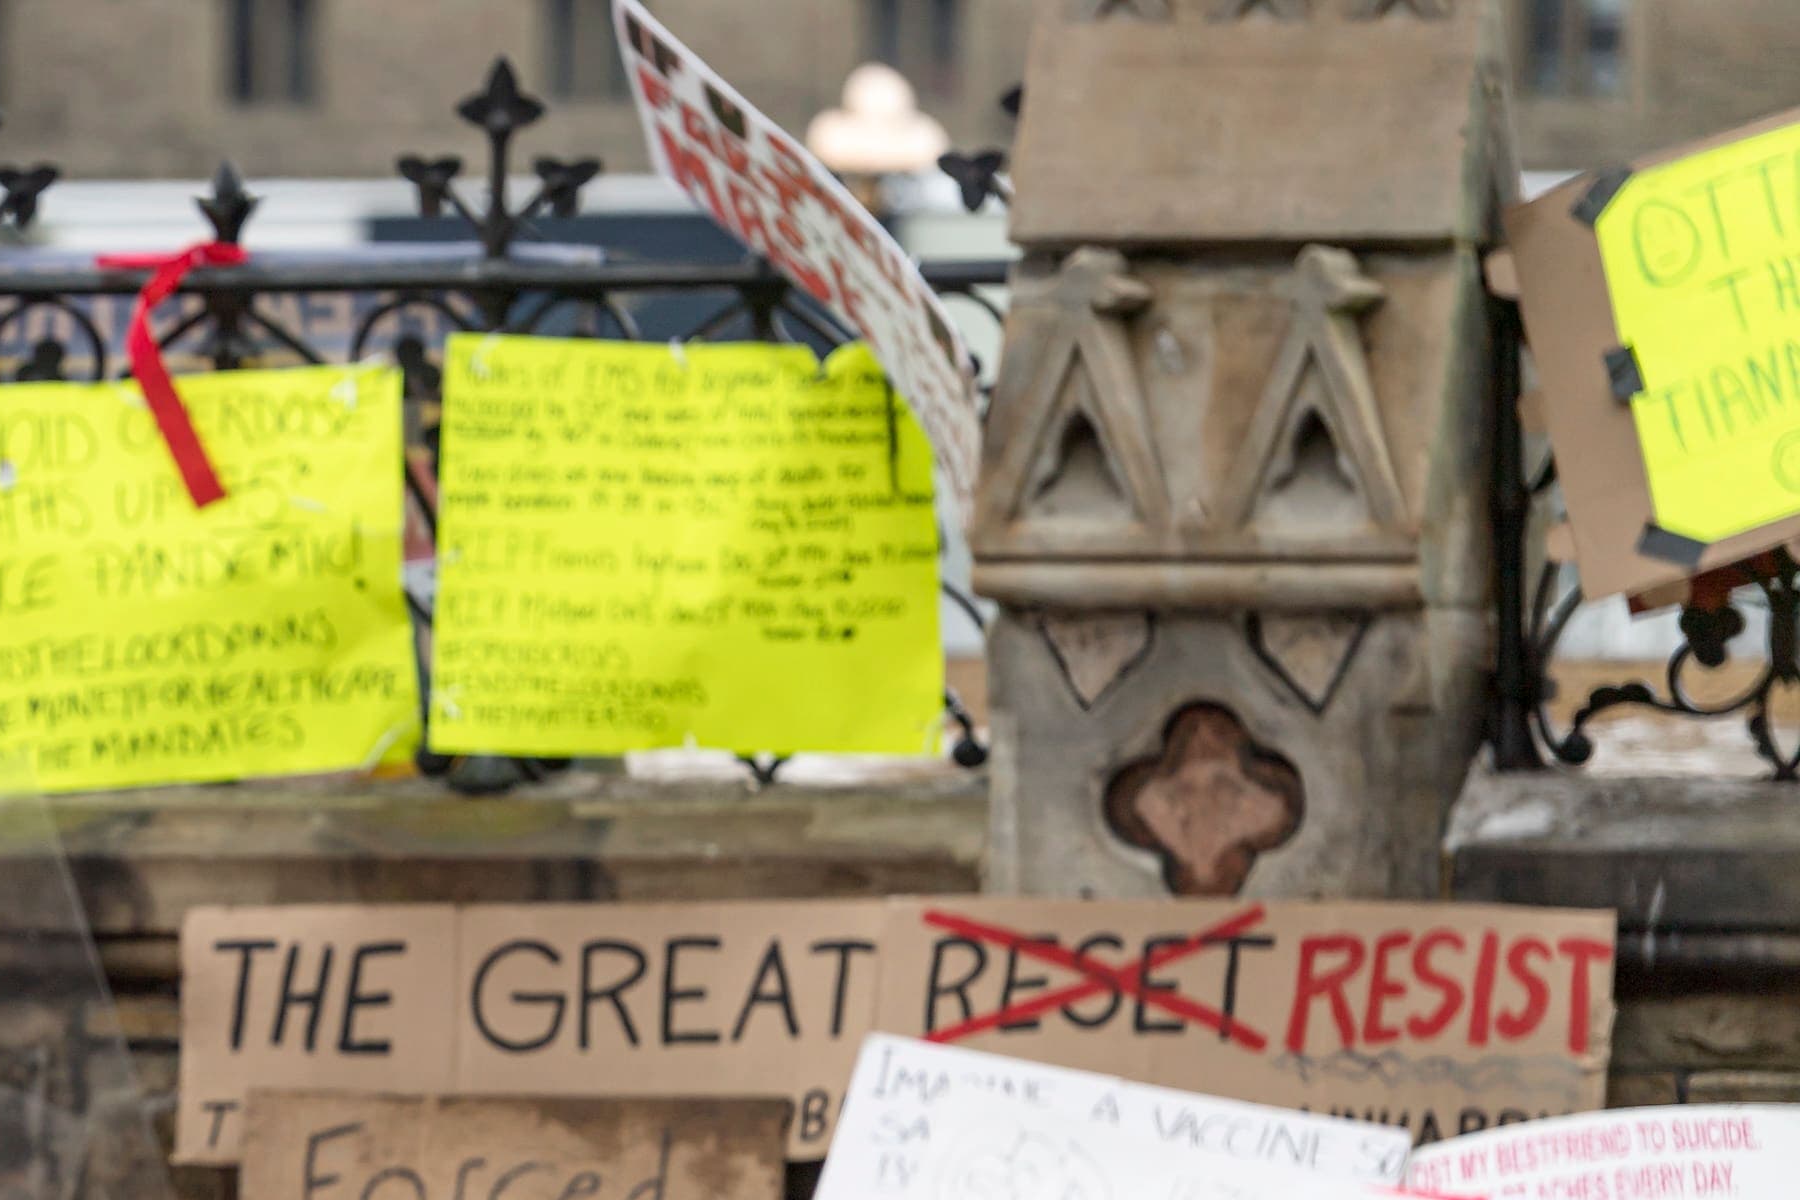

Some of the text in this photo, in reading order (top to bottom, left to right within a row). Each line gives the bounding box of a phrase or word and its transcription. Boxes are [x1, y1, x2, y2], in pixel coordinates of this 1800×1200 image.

[212, 927, 1615, 1056] THE GREAT RESET RESIST
[1637, 1121, 1667, 1154] TO
